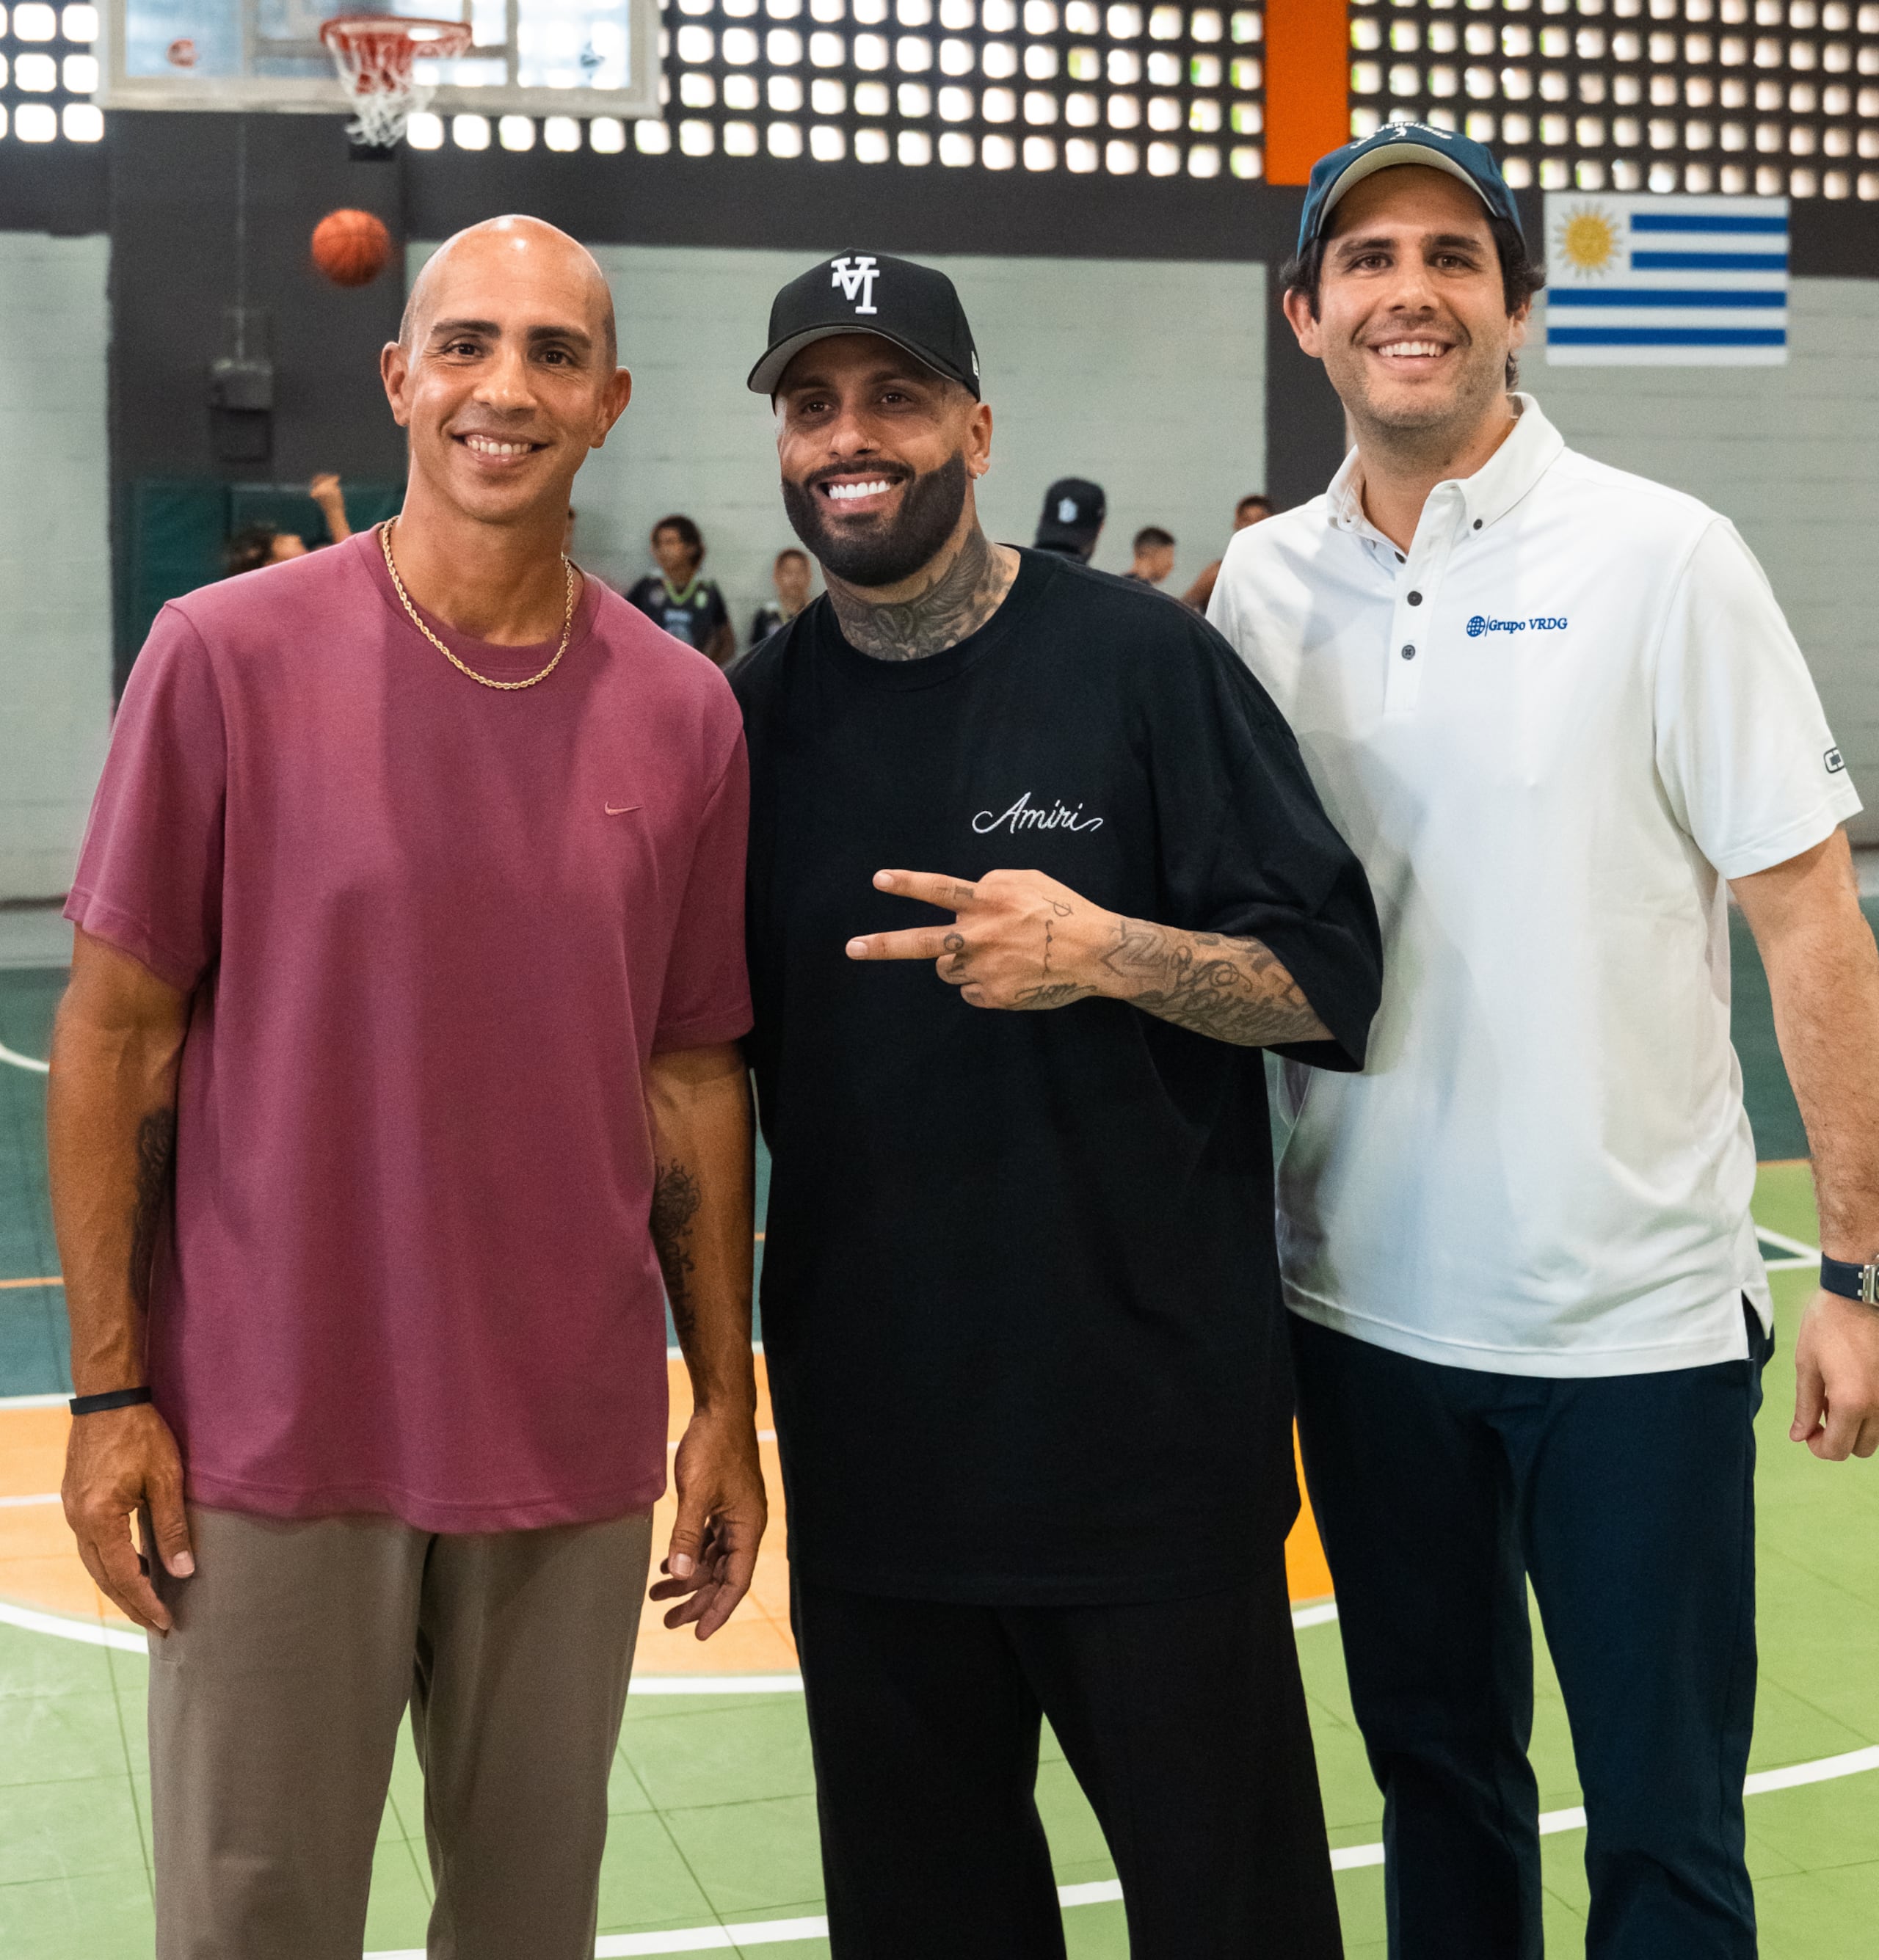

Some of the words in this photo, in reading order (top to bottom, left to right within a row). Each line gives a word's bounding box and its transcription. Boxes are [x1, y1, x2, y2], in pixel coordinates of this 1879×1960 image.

[1489, 619, 1526, 634] Grupo
[1529, 618, 1568, 630] VRDG
[971, 791, 1104, 834] Amiri
